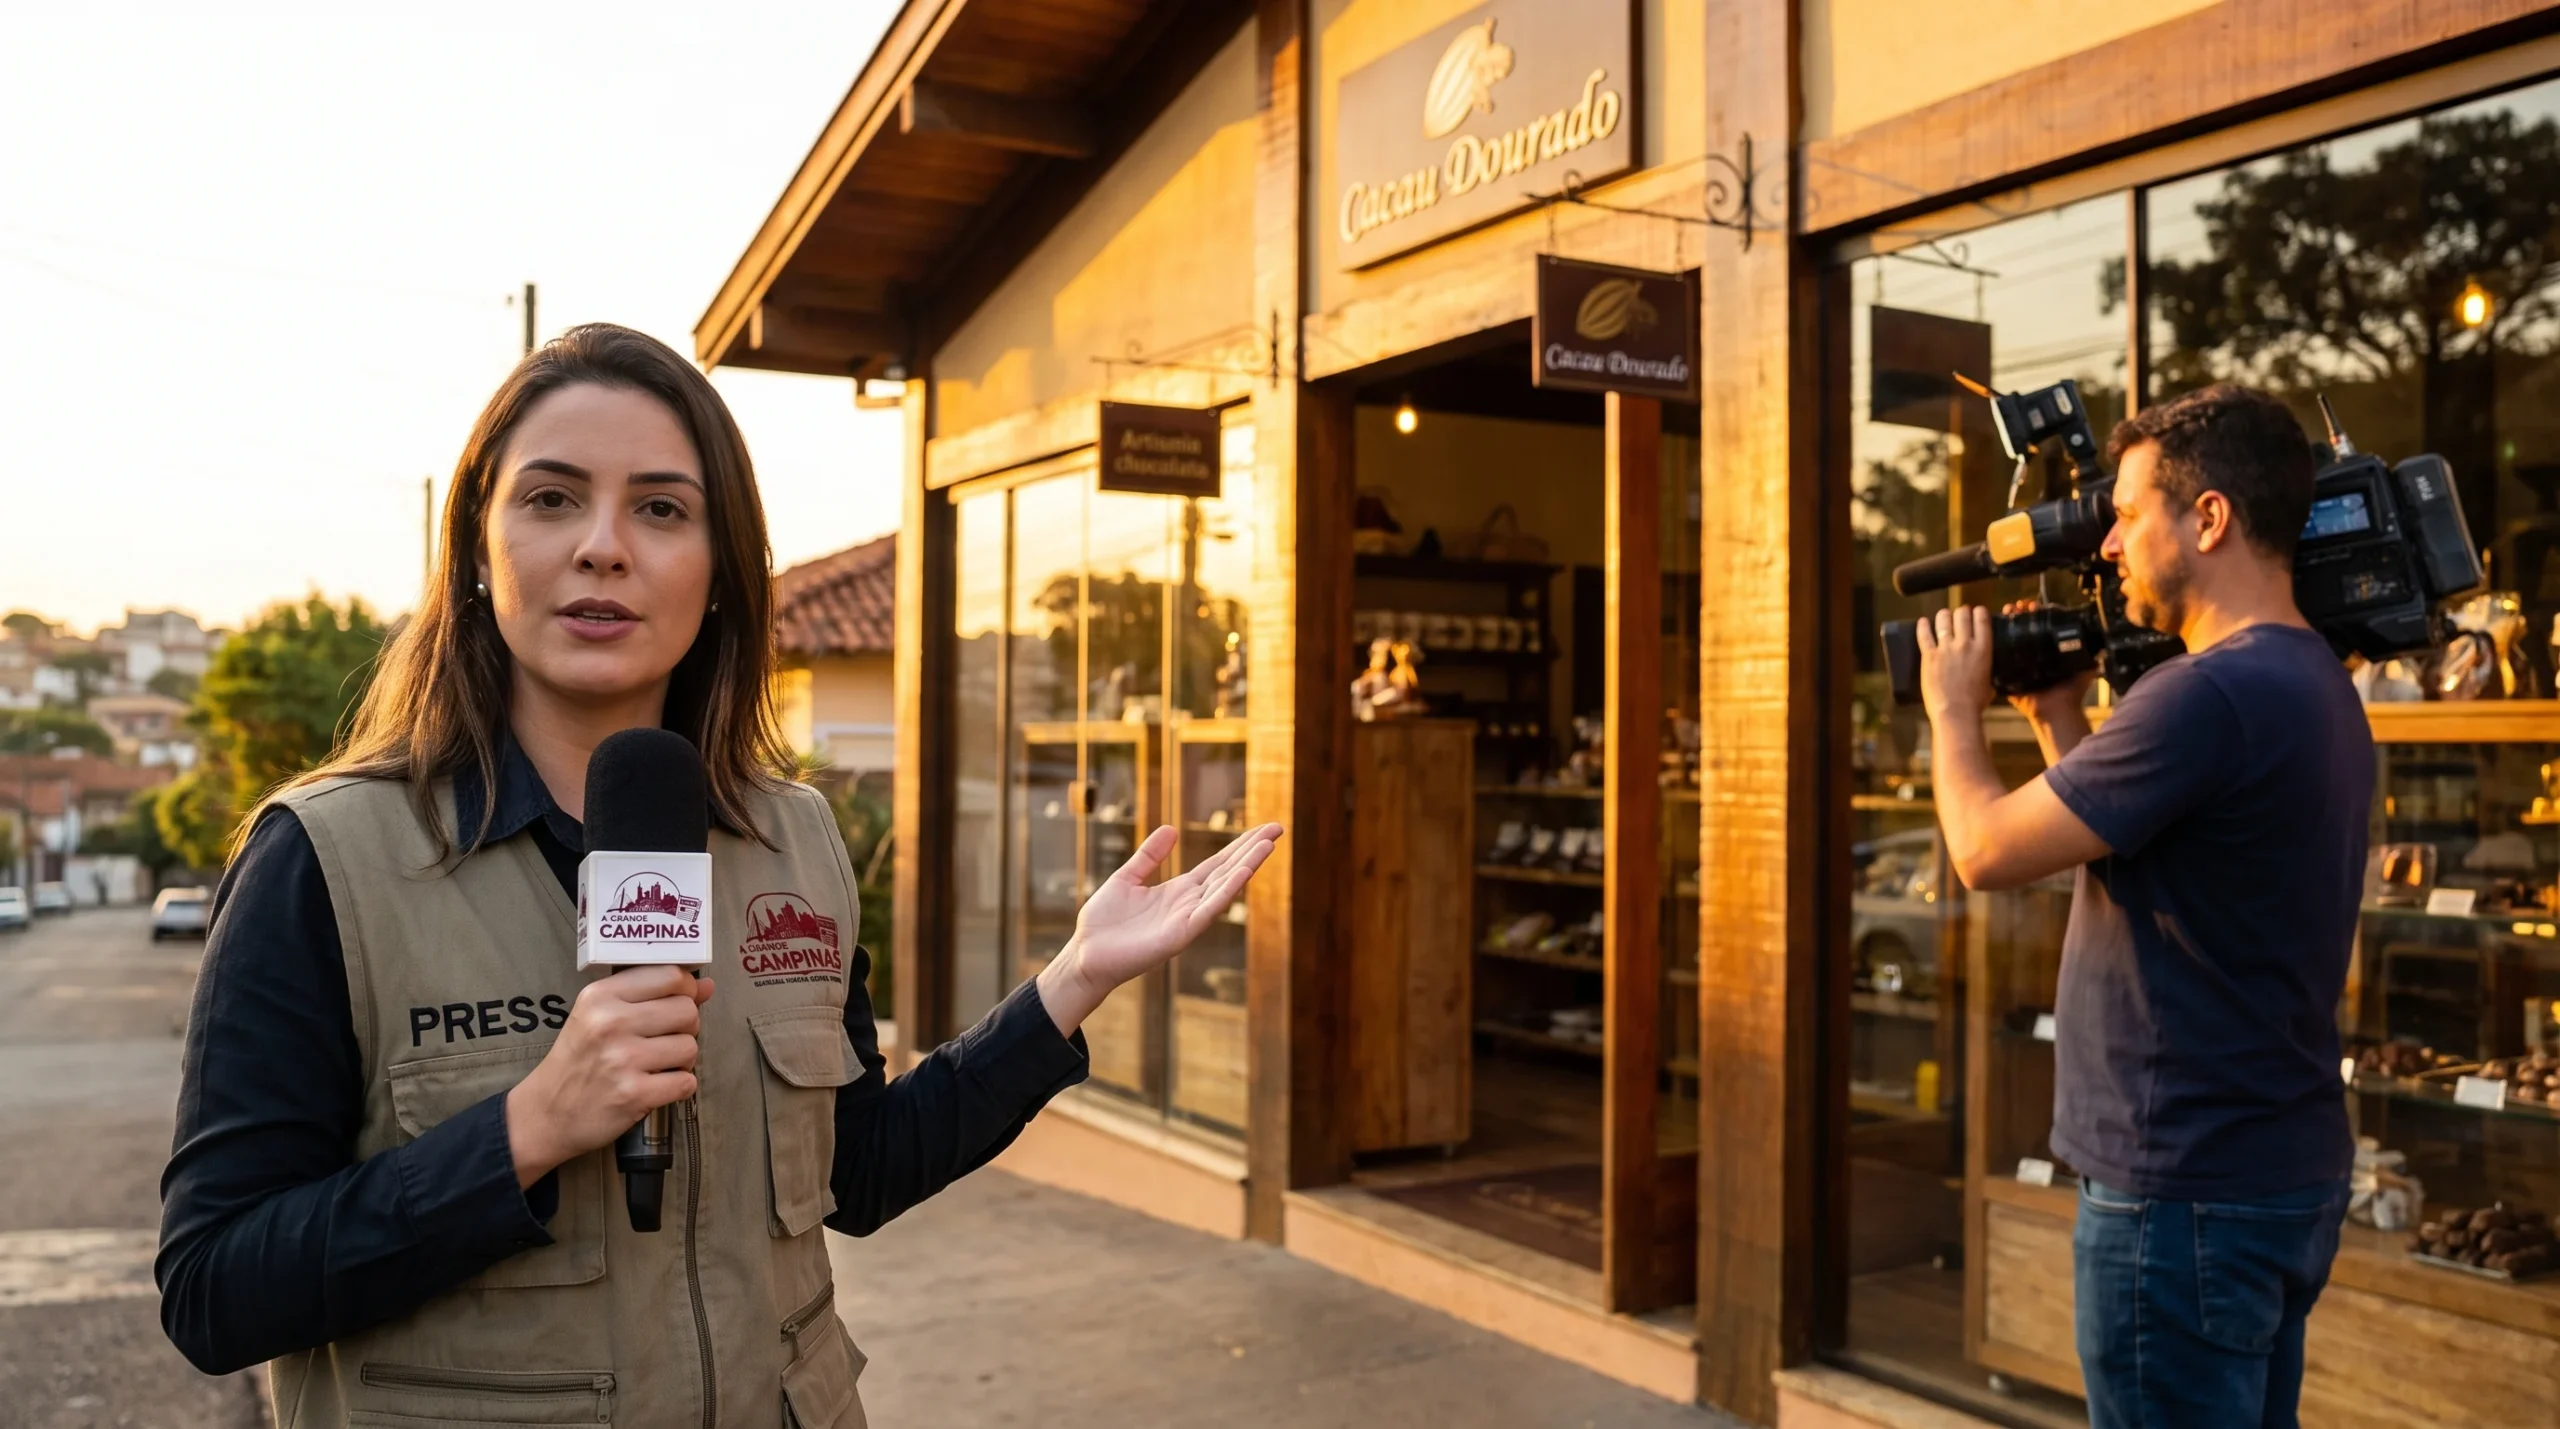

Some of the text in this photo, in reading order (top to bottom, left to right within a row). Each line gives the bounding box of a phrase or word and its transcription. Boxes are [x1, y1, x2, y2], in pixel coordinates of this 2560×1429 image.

[1340, 68, 1620, 243] Cacau Dourado
[600, 924, 700, 938] CAMPINAS
[742, 948, 842, 973] CAMPINAS
[410, 994, 570, 1047] PRESS
